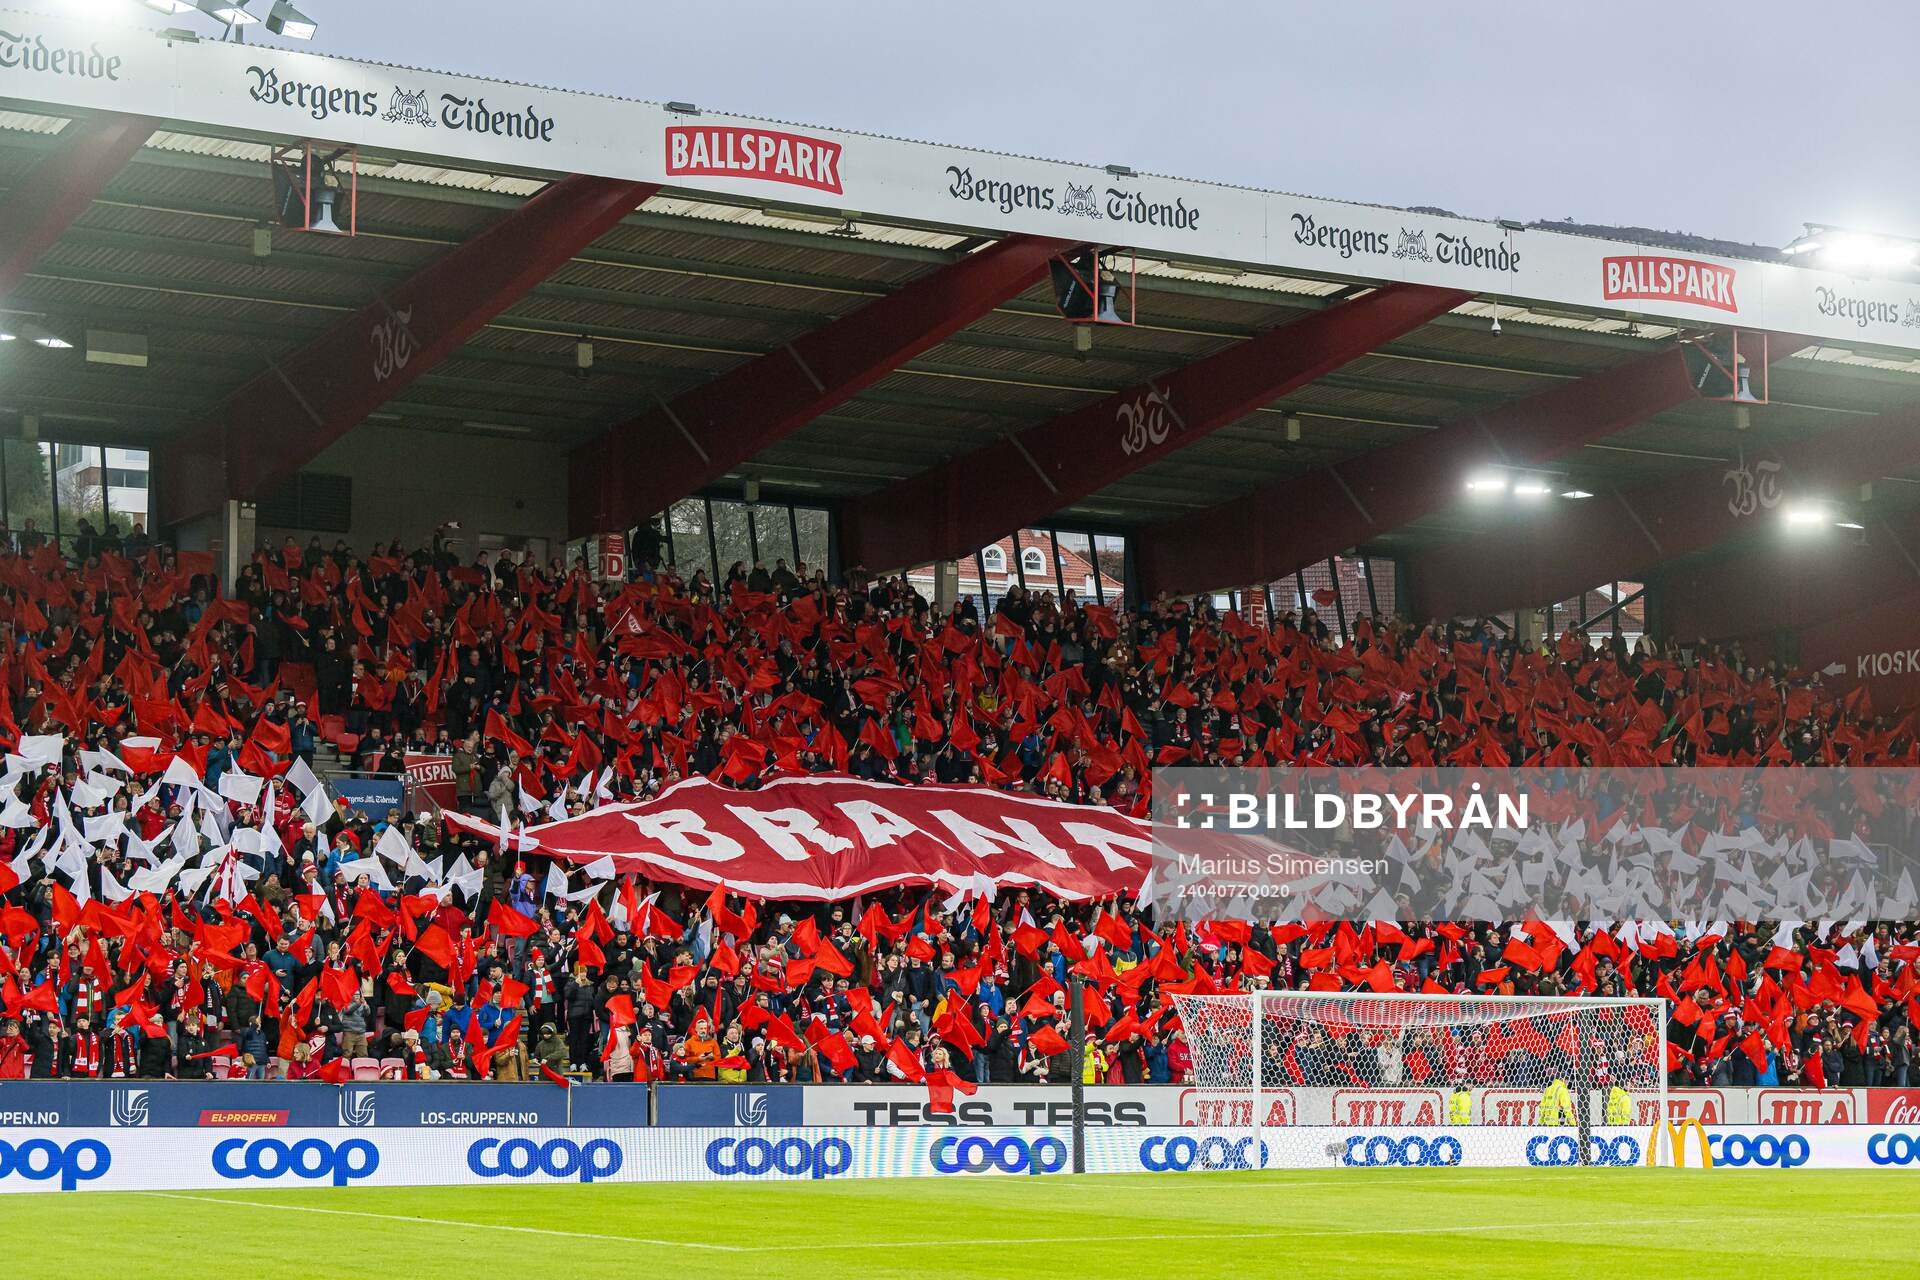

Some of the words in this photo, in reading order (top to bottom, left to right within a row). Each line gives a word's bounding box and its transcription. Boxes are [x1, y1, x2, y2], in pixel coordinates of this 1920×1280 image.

[0, 29, 121, 81] Tidende
[246, 65, 378, 120] Bergens
[440, 93, 555, 143] Tidende
[671, 131, 836, 187] BALLSPARK
[945, 165, 1054, 214] Bergens
[1105, 187, 1200, 231] Tidende
[1291, 213, 1389, 258] Bergens
[1435, 232, 1521, 273] Tidende
[1607, 263, 1731, 306] BALLSPARK
[1815, 286, 1899, 328] Bergens
[607, 555, 623, 577] D
[1857, 649, 1920, 678] KIOSK
[211, 1114, 277, 1122] EL-PROFFEN
[420, 1111, 538, 1125] LOS-GRUPPEN.NO
[211, 1138, 380, 1187] coop
[467, 1137, 623, 1183] coop
[705, 1137, 853, 1179] coop
[929, 1136, 1068, 1175] coop
[1342, 1135, 1463, 1167] coop
[1707, 1134, 1810, 1168] coop
